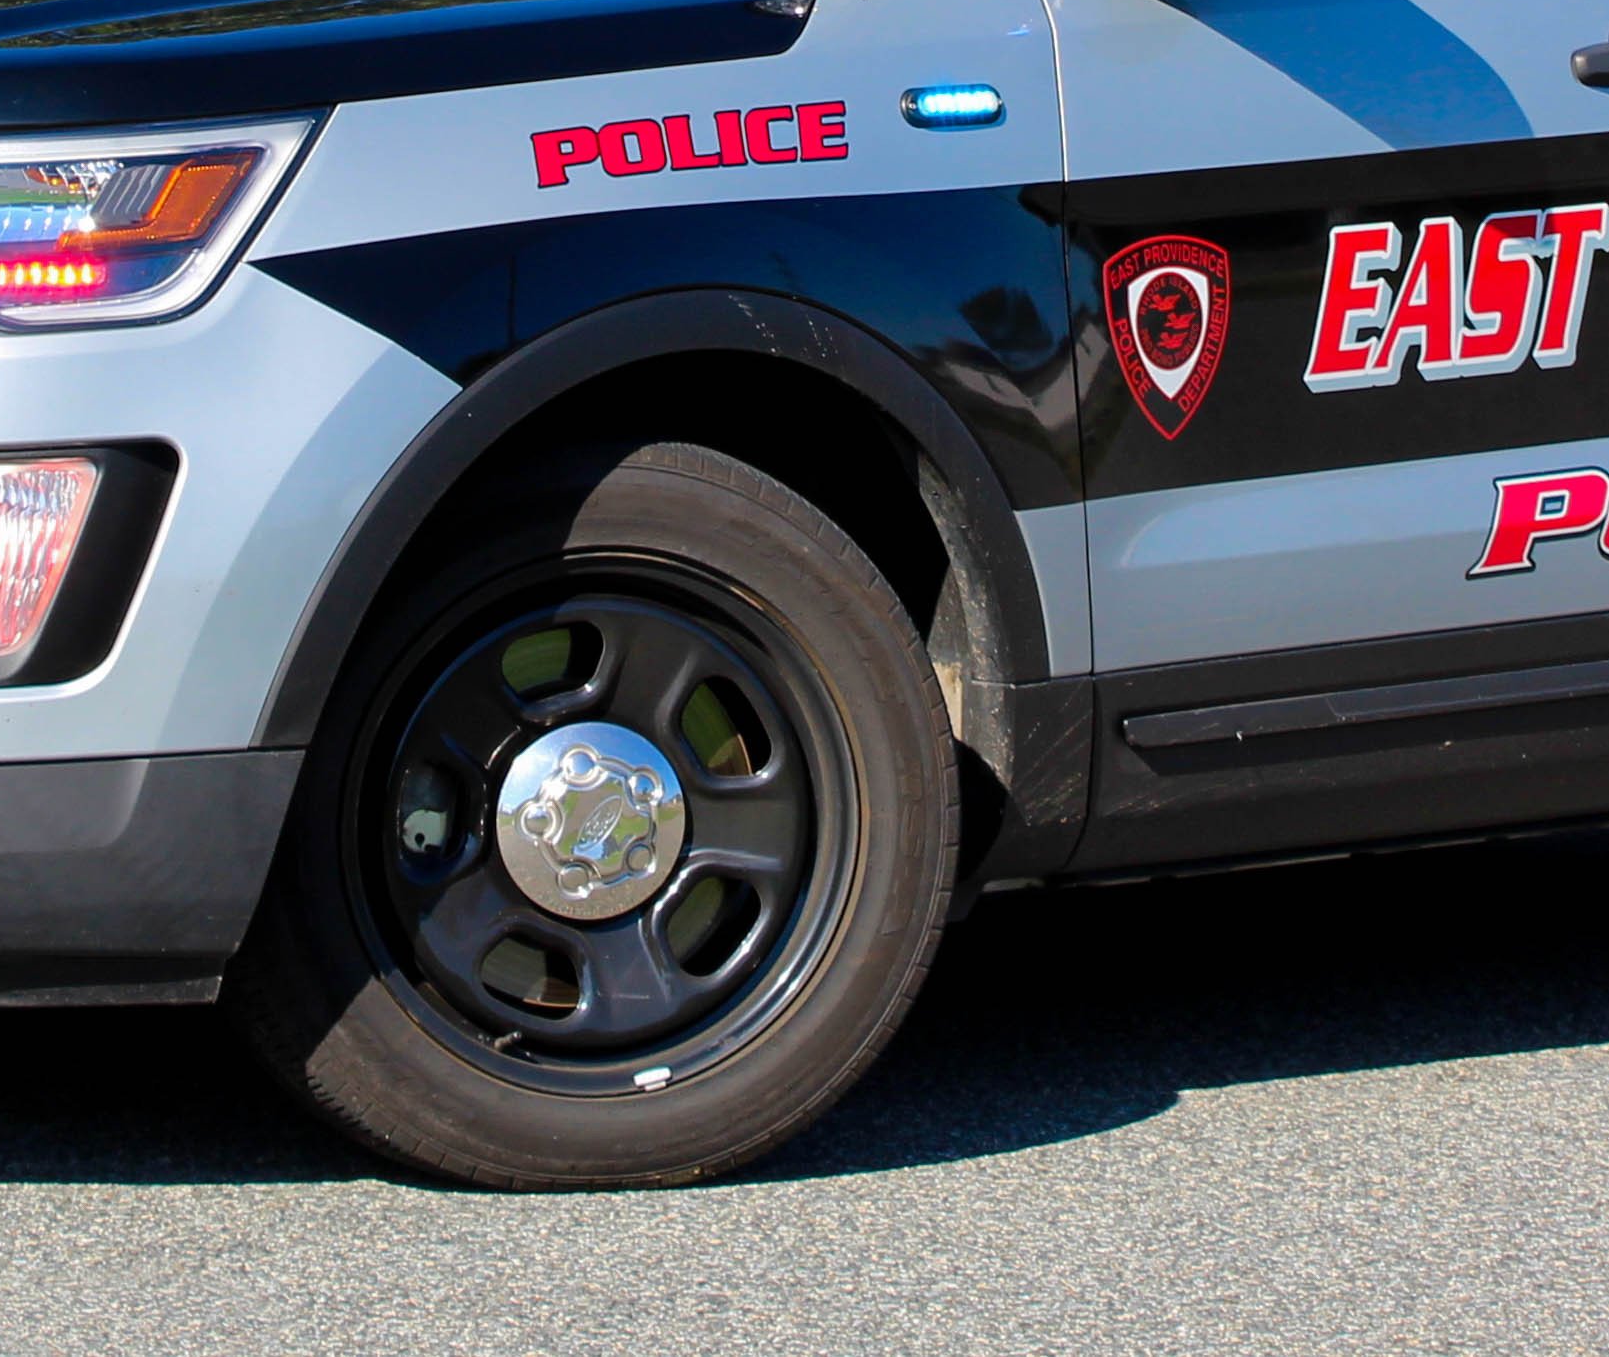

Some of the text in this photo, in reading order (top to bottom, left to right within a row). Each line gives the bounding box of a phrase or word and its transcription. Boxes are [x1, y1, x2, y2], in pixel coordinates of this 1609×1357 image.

[530, 100, 849, 188] POLICE
[1110, 243, 1225, 290] EAST PROVIDENCE
[1113, 317, 1154, 398] POLICE
[1177, 285, 1226, 412] DEPARTMENT
